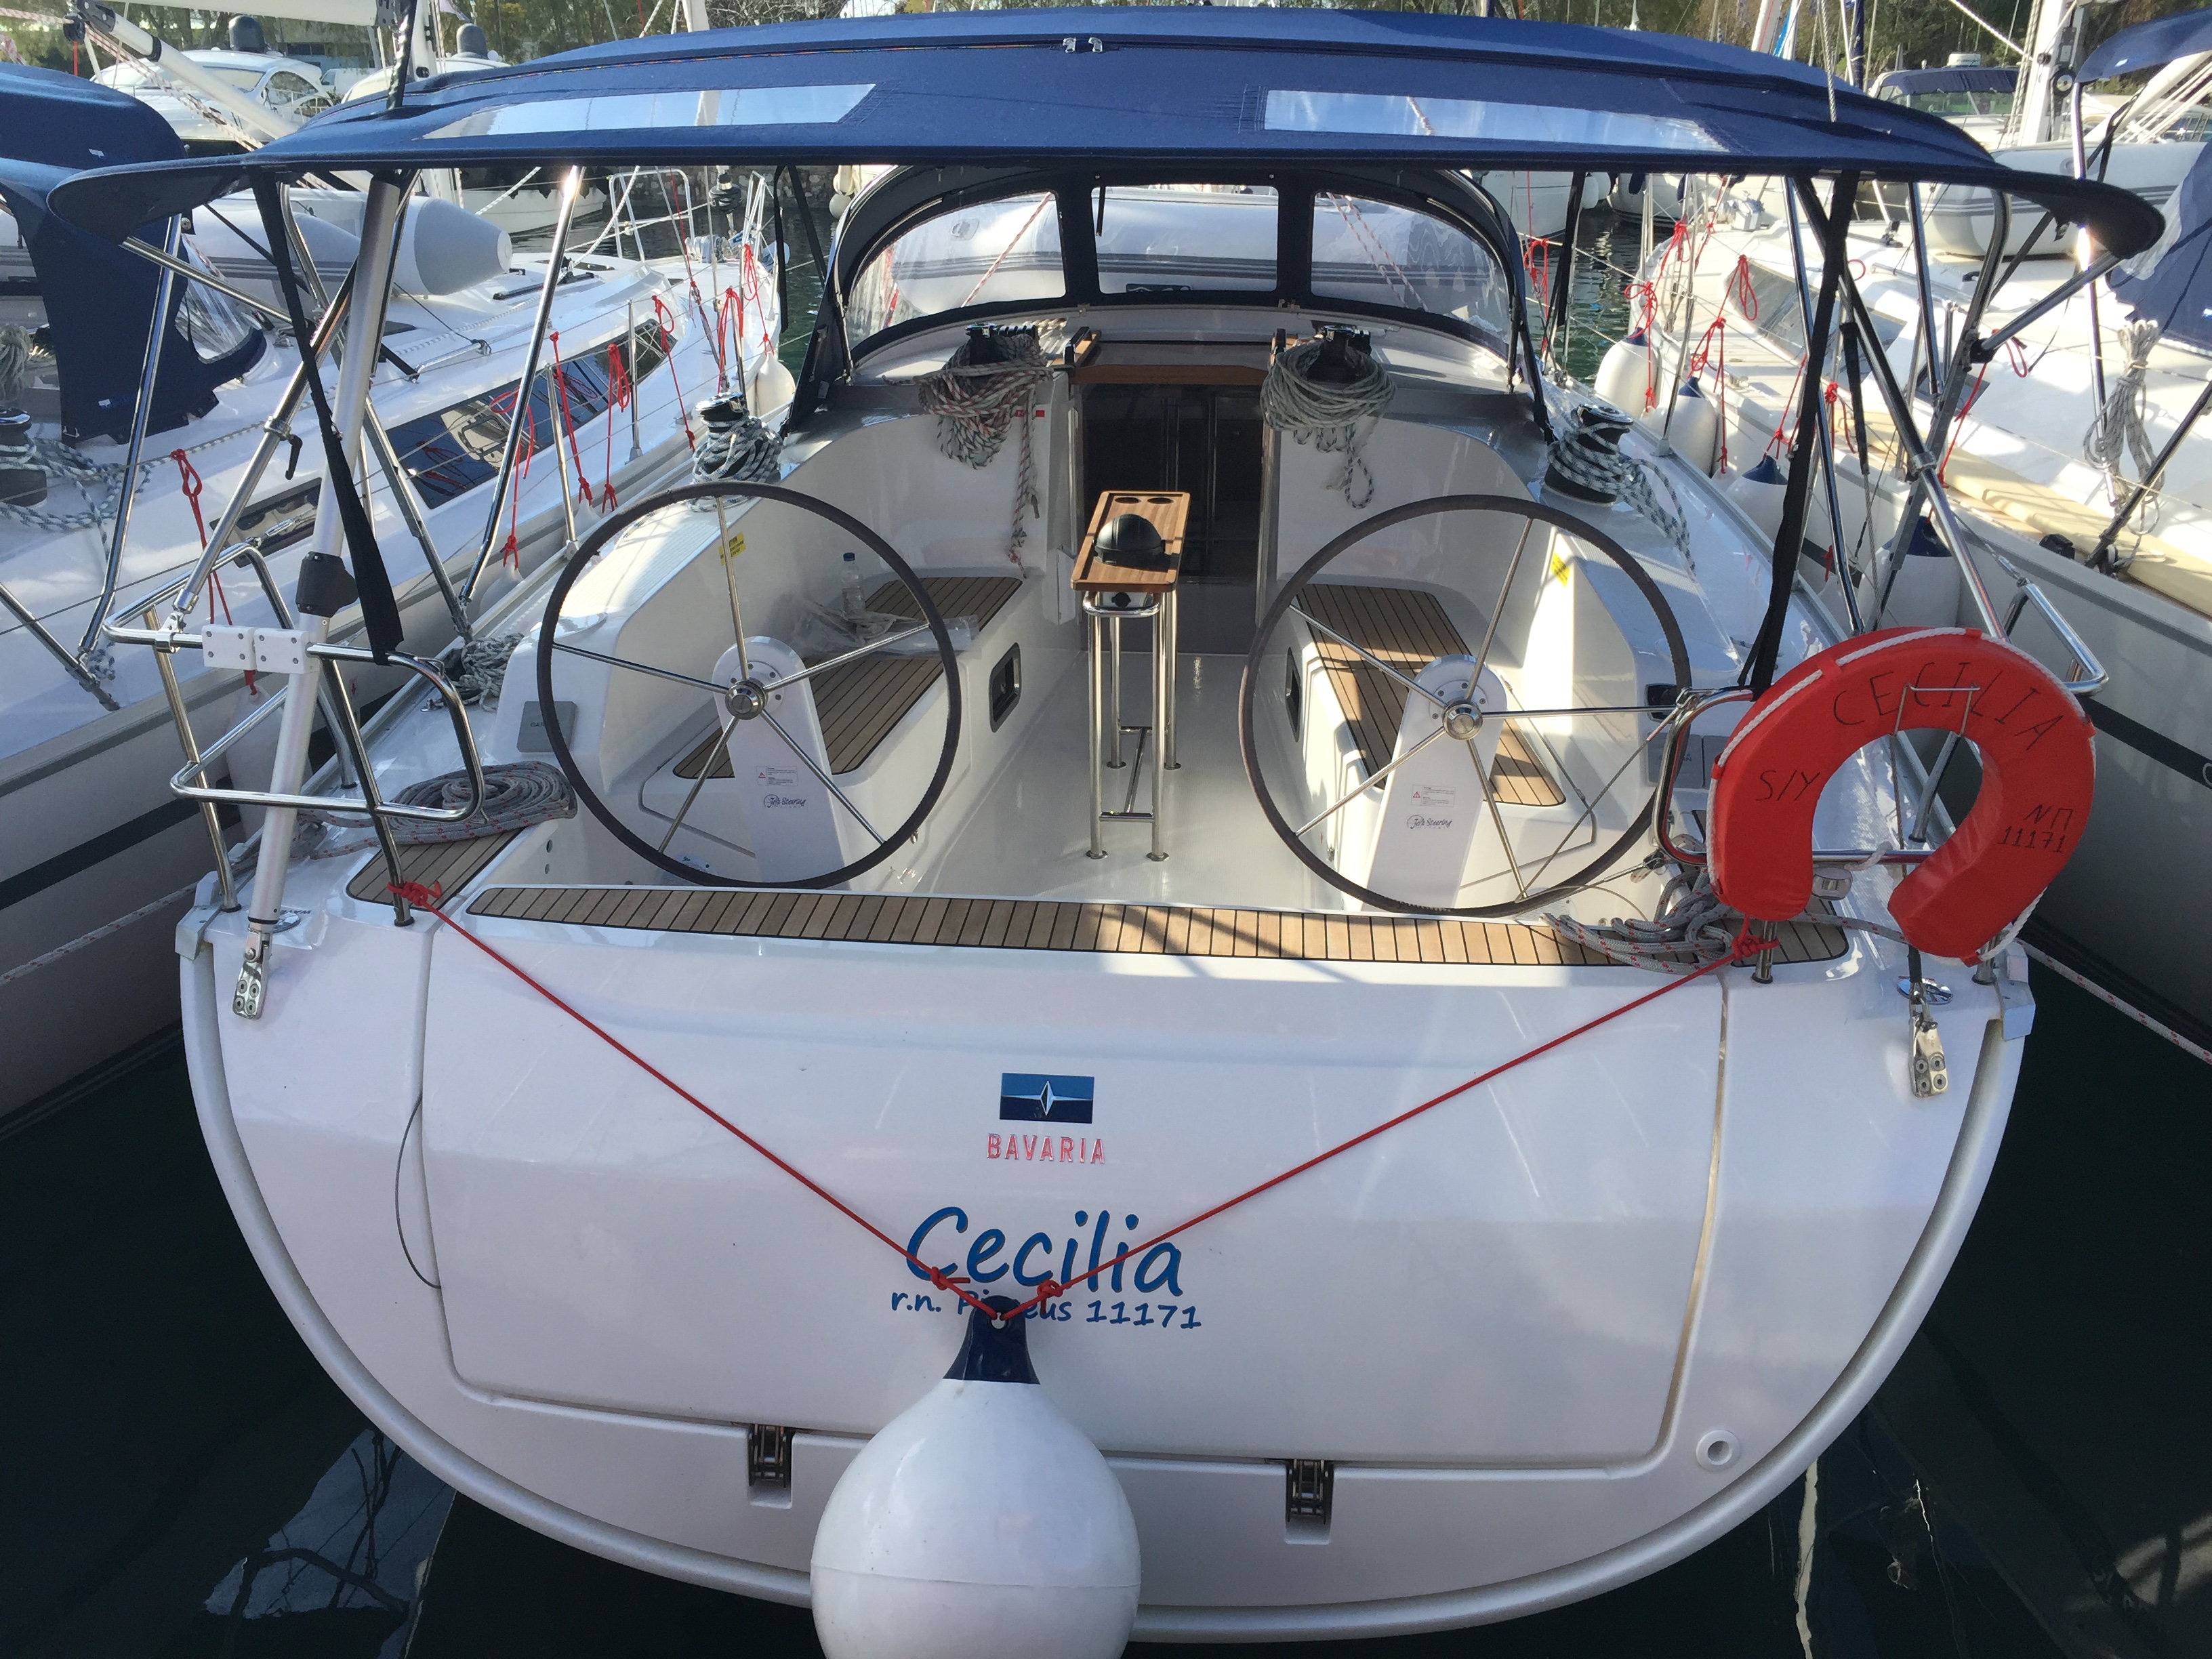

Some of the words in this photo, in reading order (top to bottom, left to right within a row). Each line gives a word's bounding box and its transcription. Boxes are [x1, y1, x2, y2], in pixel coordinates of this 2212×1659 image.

[1755, 770, 1821, 801] S/Y
[1833, 662, 2064, 751] CECILIA
[1997, 825, 2066, 853] 11171
[987, 1132, 1105, 1165] BAVARIA
[906, 1206, 1183, 1297] Cecilia
[891, 1292, 942, 1313] r.n.
[1086, 1300, 1202, 1329] 11171
